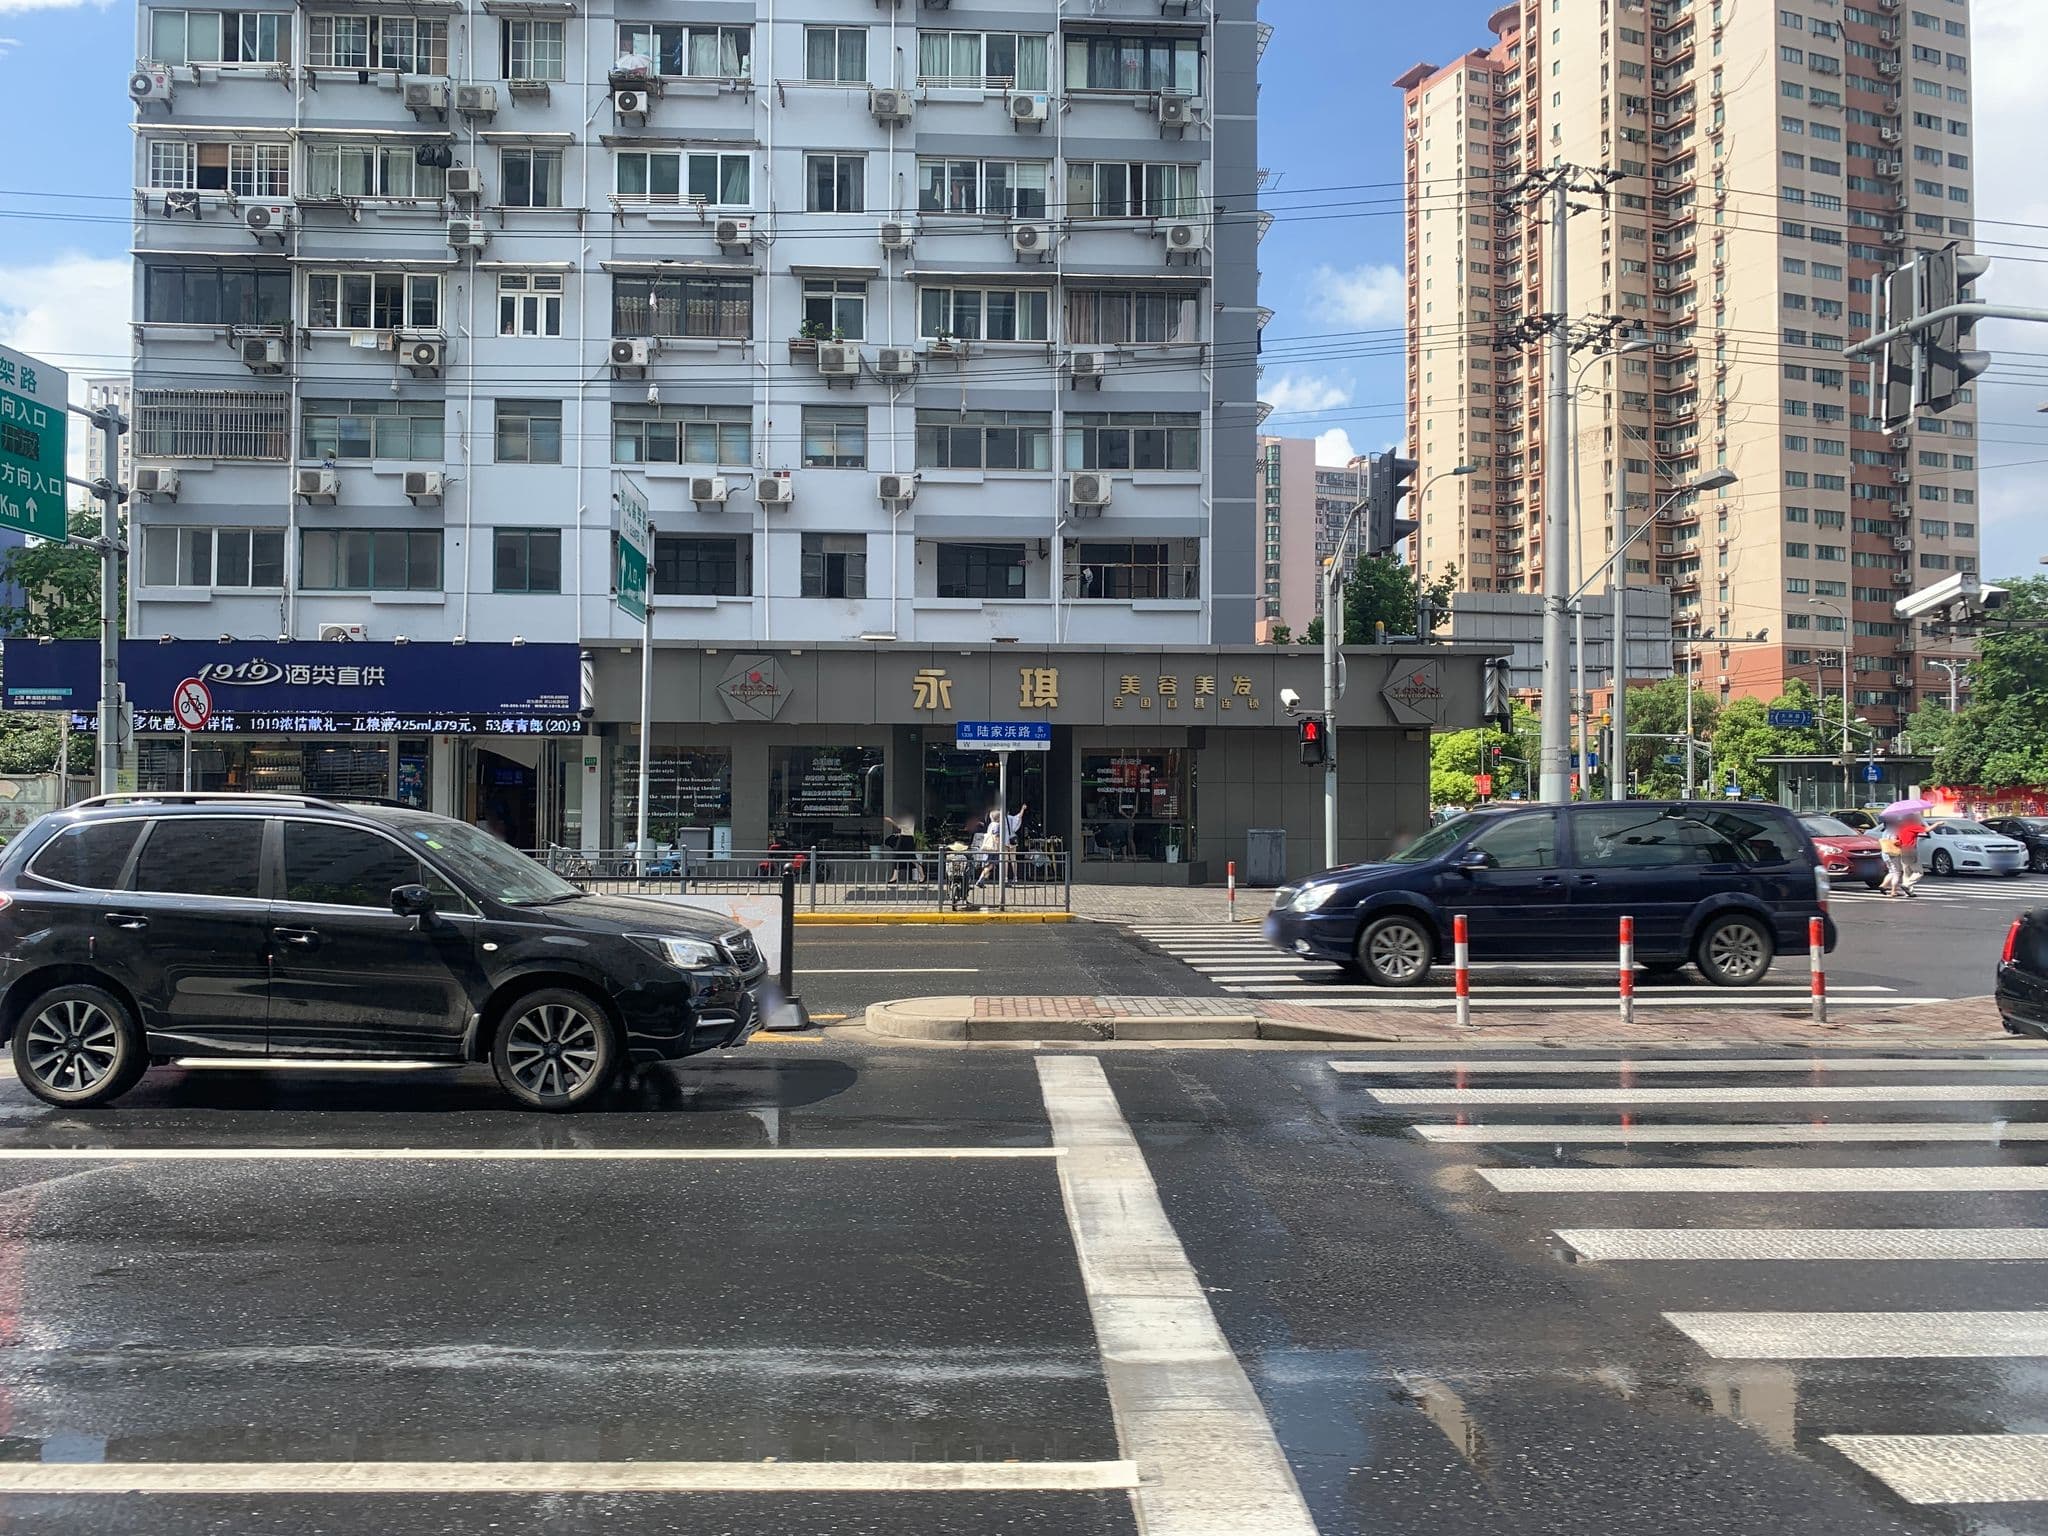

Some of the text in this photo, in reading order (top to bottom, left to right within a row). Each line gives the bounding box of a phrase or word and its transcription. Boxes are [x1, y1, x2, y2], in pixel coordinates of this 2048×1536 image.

[1, 462, 62, 497] 方向入口
[285, 664, 385, 686] 酒类直供
[1120, 674, 1252, 695] 美容美发
[1113, 696, 1260, 709] 全国直营连锁
[977, 725, 1031, 738] 陆家浜路
